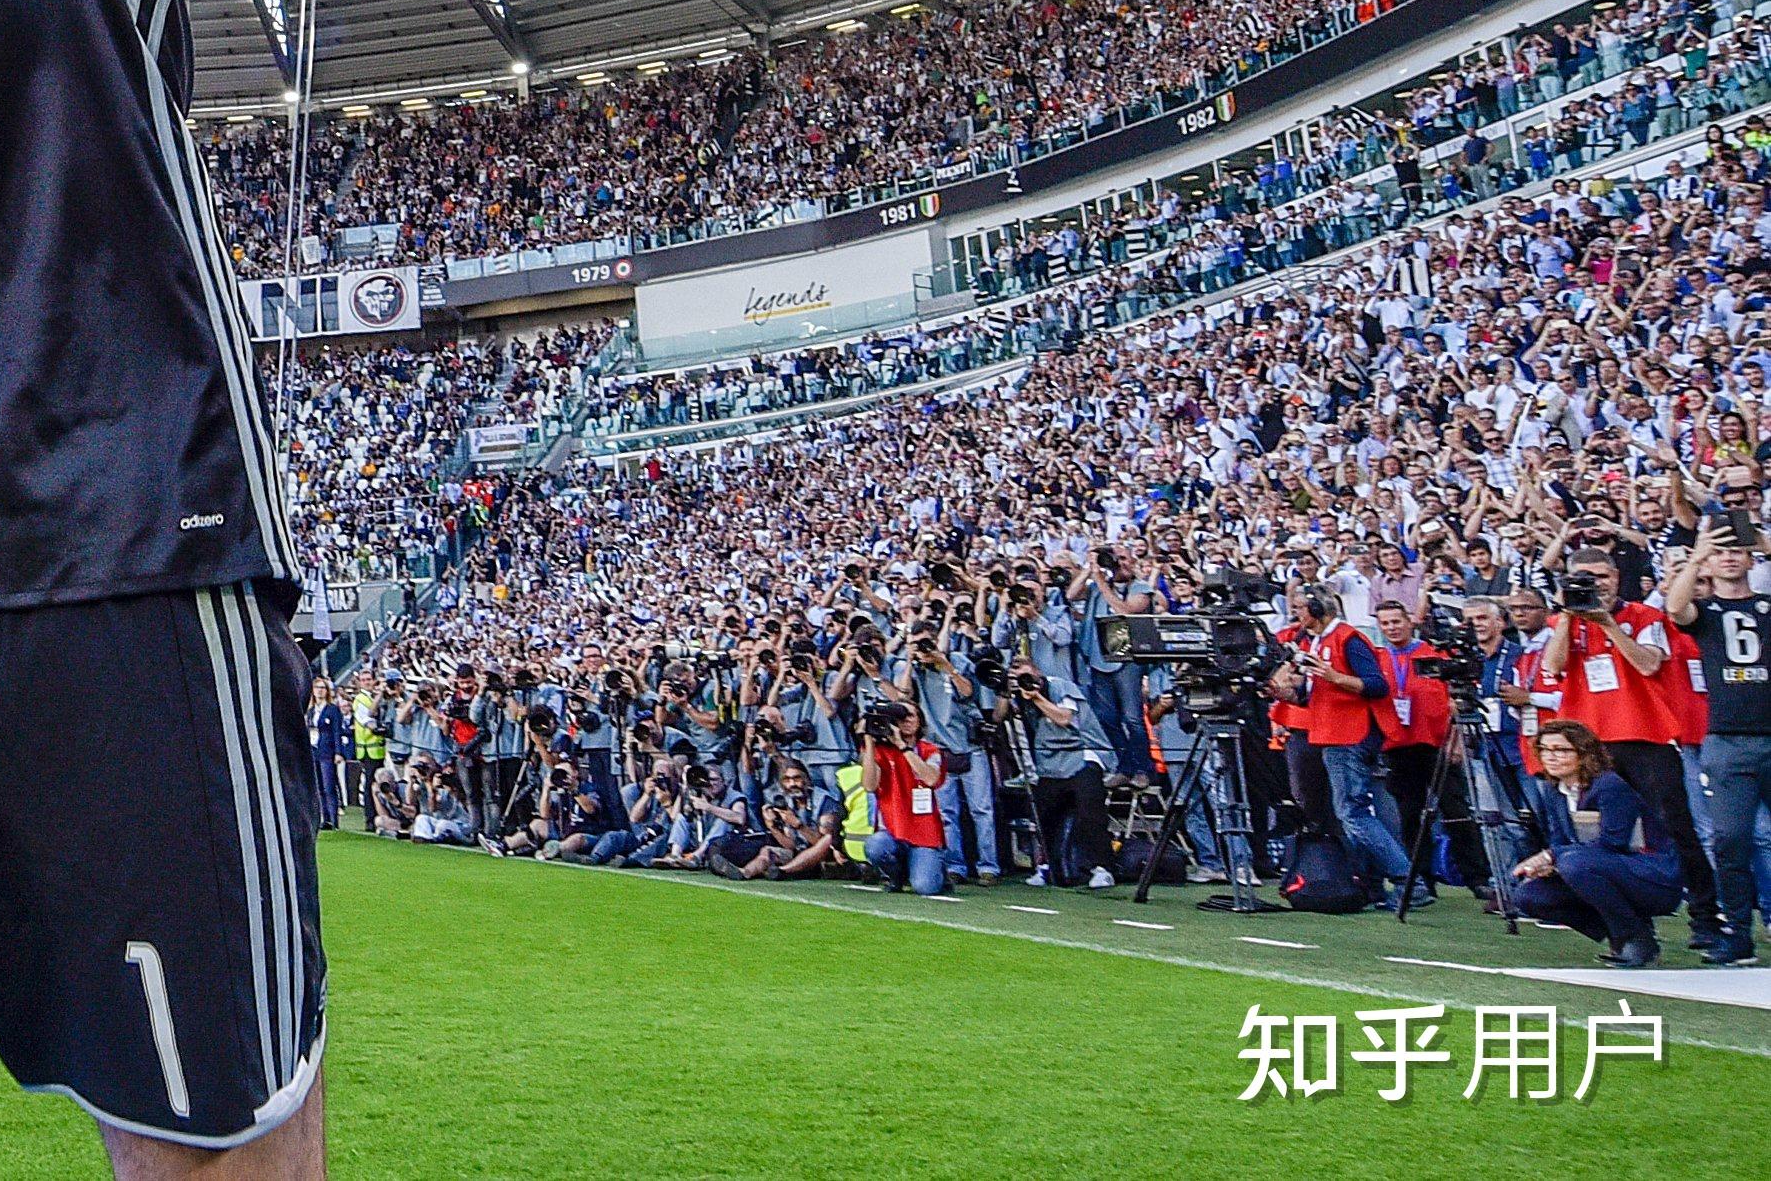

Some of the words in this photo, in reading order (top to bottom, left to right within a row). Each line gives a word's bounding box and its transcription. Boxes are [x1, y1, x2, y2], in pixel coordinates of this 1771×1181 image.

[1177, 105, 1217, 136] 1982
[879, 202, 917, 226] 1981
[571, 265, 611, 284] 1979
[1722, 610, 1761, 664] 6
[125, 940, 191, 1118] 1
